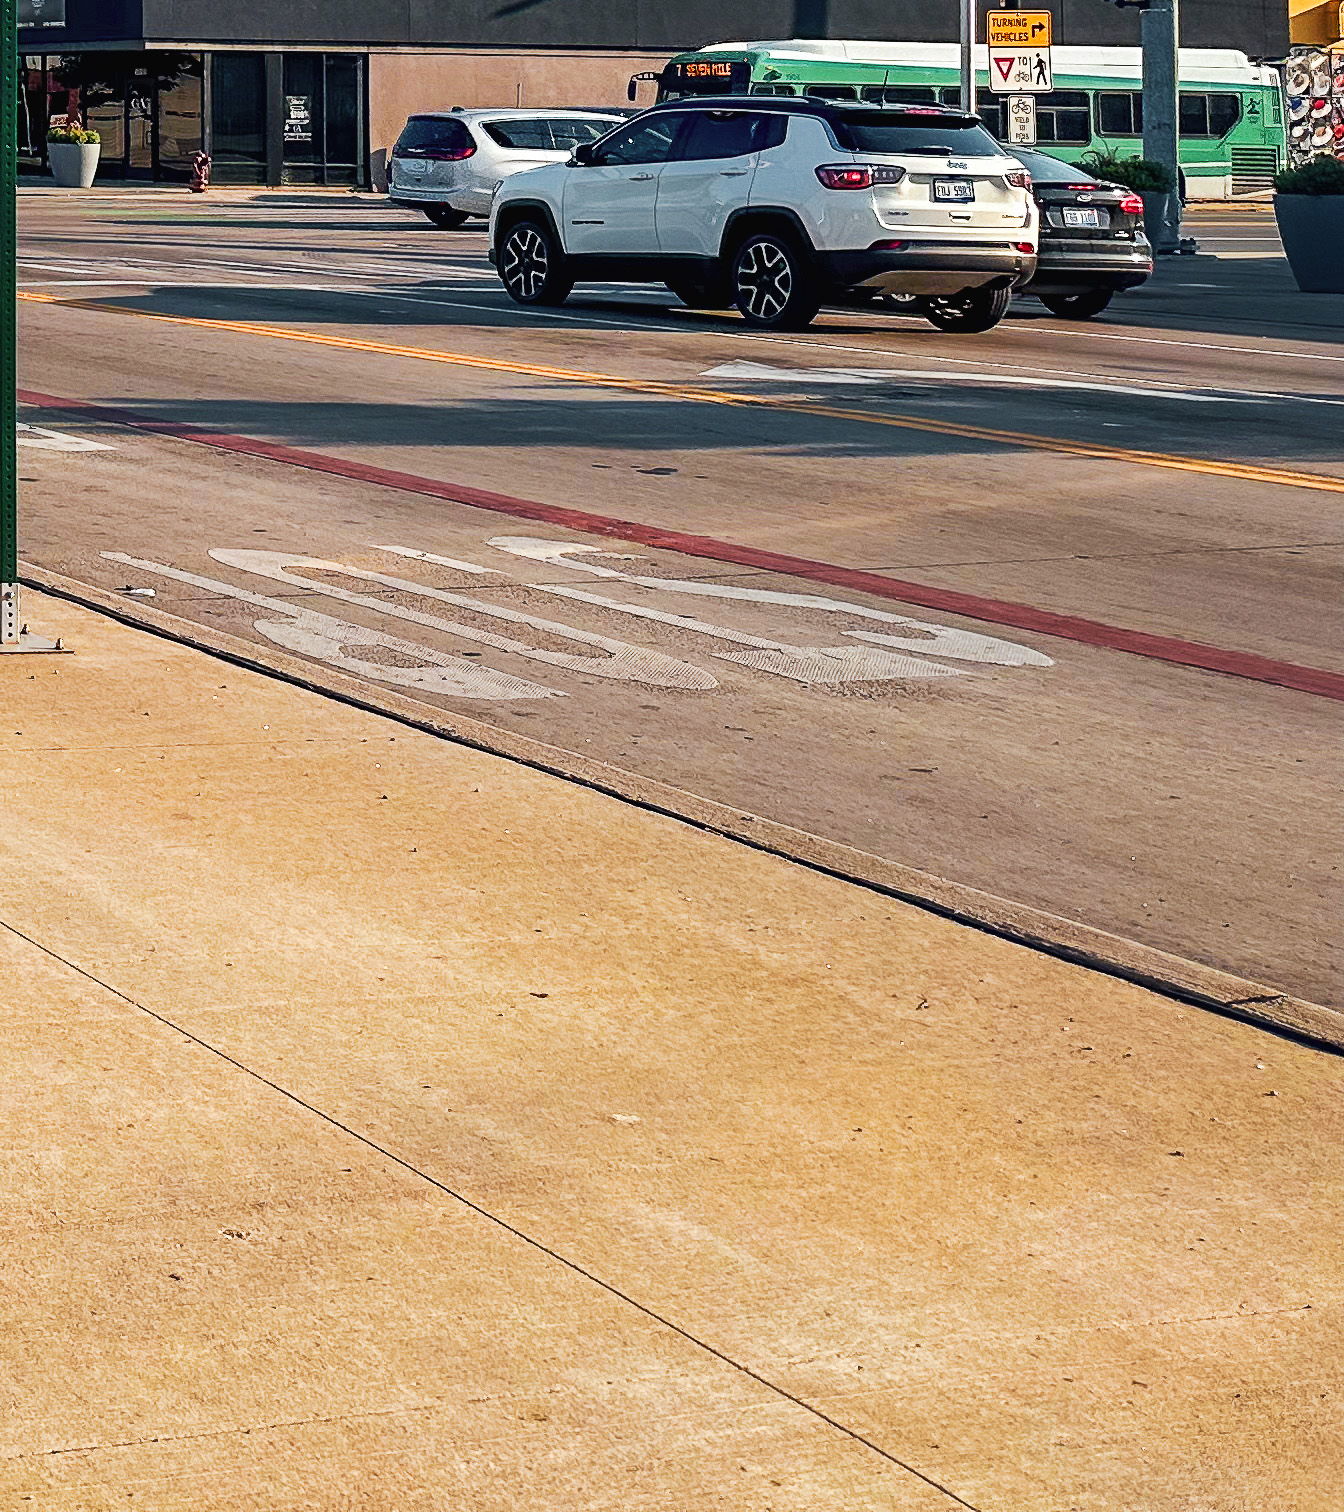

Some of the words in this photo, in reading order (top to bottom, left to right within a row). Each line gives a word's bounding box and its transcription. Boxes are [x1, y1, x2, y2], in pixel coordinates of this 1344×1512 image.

[991, 17, 1028, 28] TURNING
[990, 31, 1030, 43] VEHICLES
[1017, 56, 1028, 66] TO
[676, 64, 682, 77] 7
